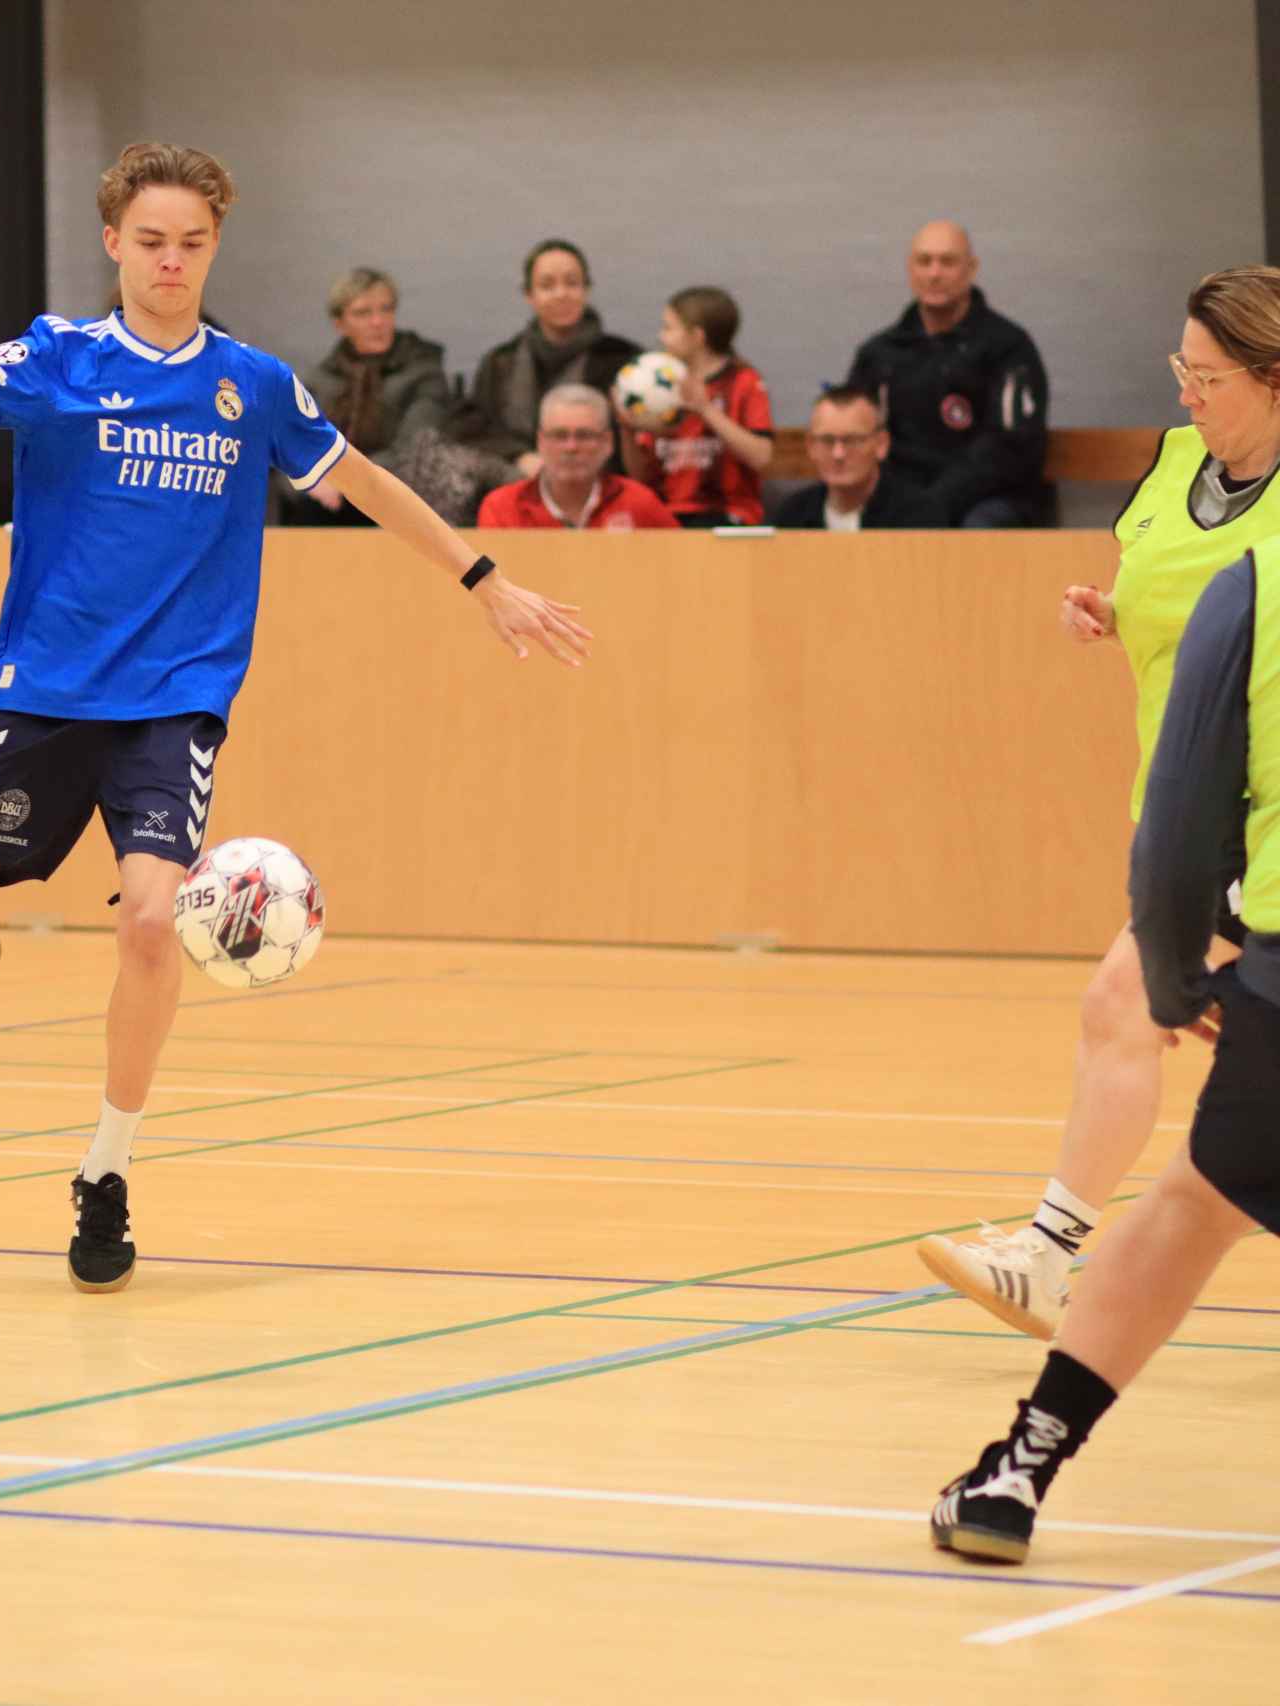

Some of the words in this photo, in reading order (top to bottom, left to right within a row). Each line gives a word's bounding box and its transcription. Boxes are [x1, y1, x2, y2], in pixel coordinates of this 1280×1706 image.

[98, 418, 242, 465] Emirates
[118, 458, 154, 487] FLY
[158, 461, 227, 495] BETTER
